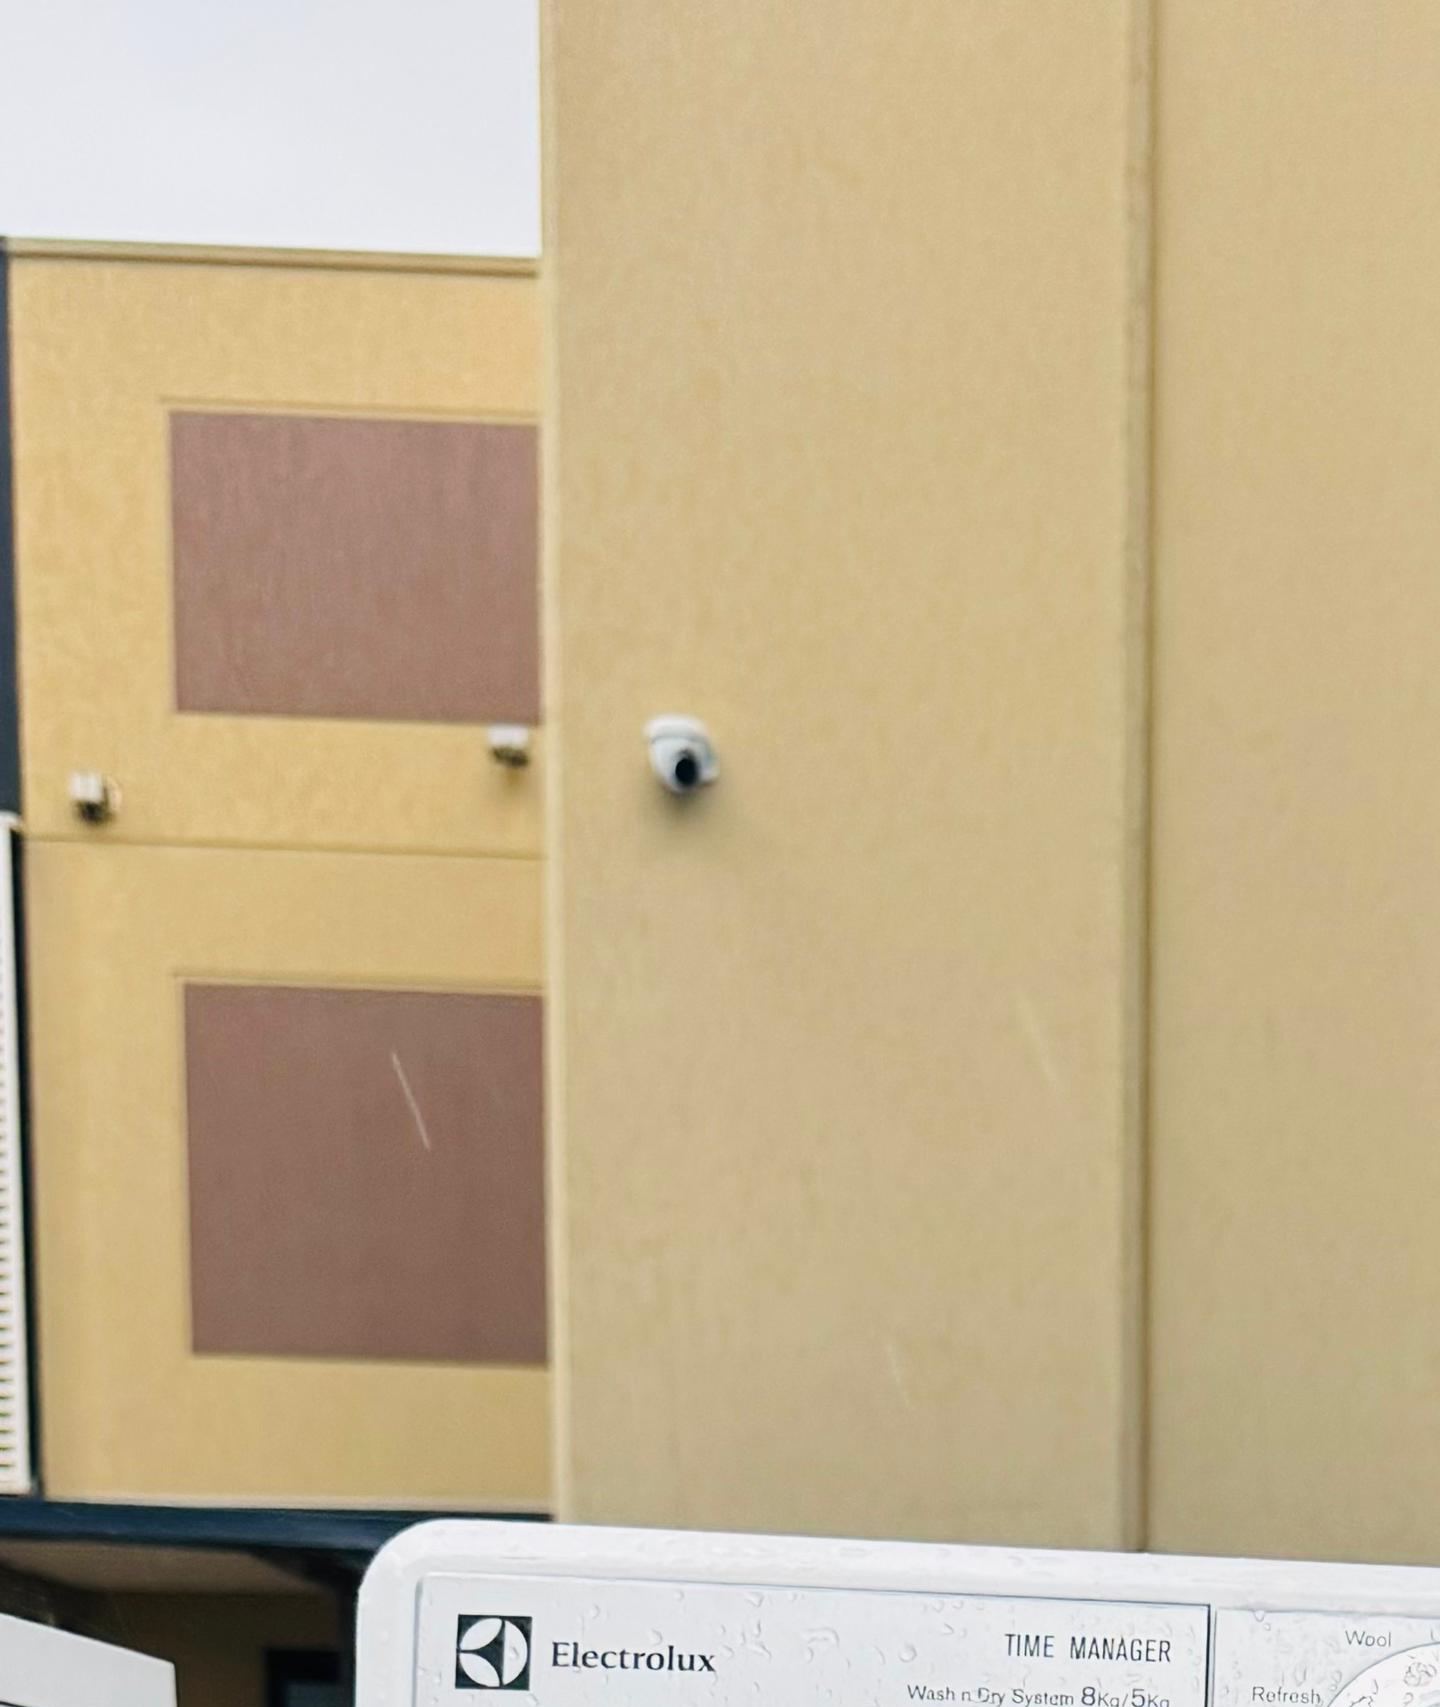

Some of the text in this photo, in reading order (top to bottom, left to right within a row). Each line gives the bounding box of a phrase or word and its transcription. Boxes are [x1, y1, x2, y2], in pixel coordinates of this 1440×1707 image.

[1005, 1633, 1171, 1663] TIME MANAGER
[1345, 1630, 1392, 1648] Wool
[551, 1641, 716, 1673] Electrolux
[907, 1684, 955, 1702] Wash
[1012, 1688, 1074, 1707] System
[1252, 1686, 1320, 1705] Refresh
